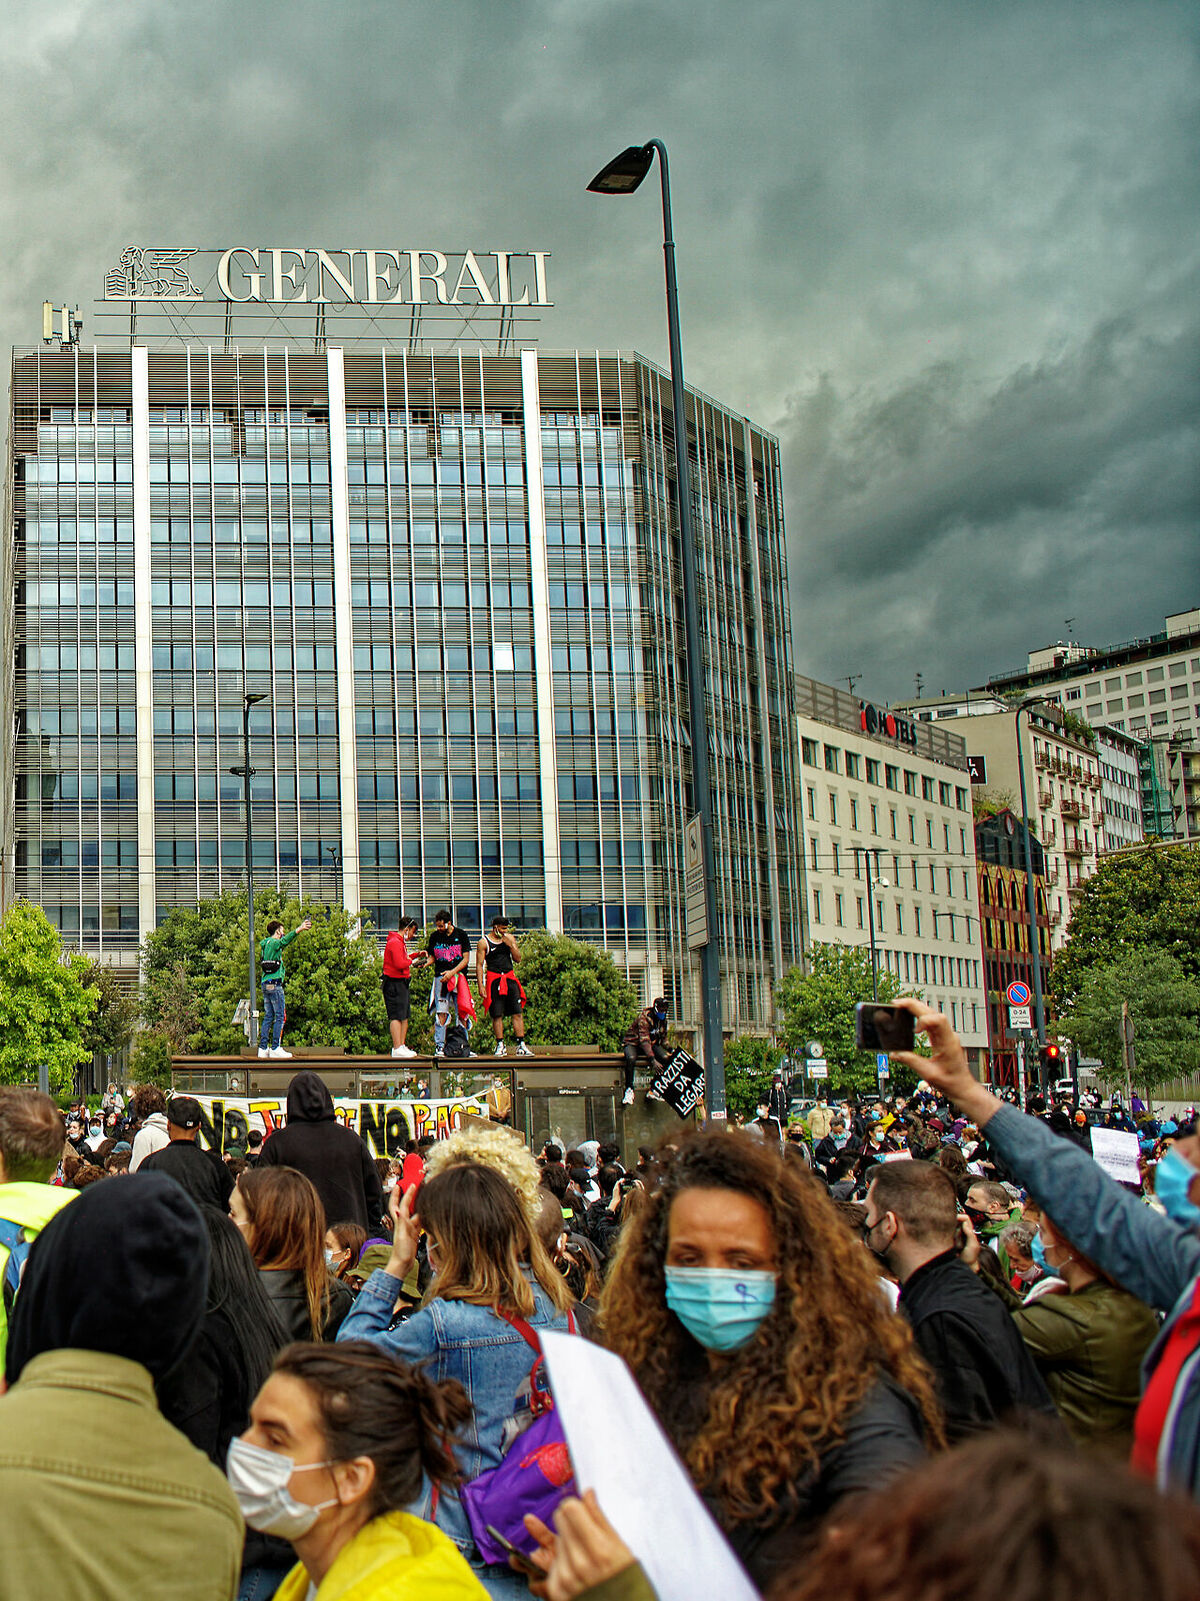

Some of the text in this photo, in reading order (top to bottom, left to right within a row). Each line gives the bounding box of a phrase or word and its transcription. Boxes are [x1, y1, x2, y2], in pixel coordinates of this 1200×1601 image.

[217, 247, 554, 307] GENERALI
[878, 710, 917, 746] HOTELS
[655, 1051, 691, 1094] RAZZISTI
[674, 1075, 692, 1092] DA
[196, 1100, 250, 1156] NO
[359, 1103, 412, 1159] NO
